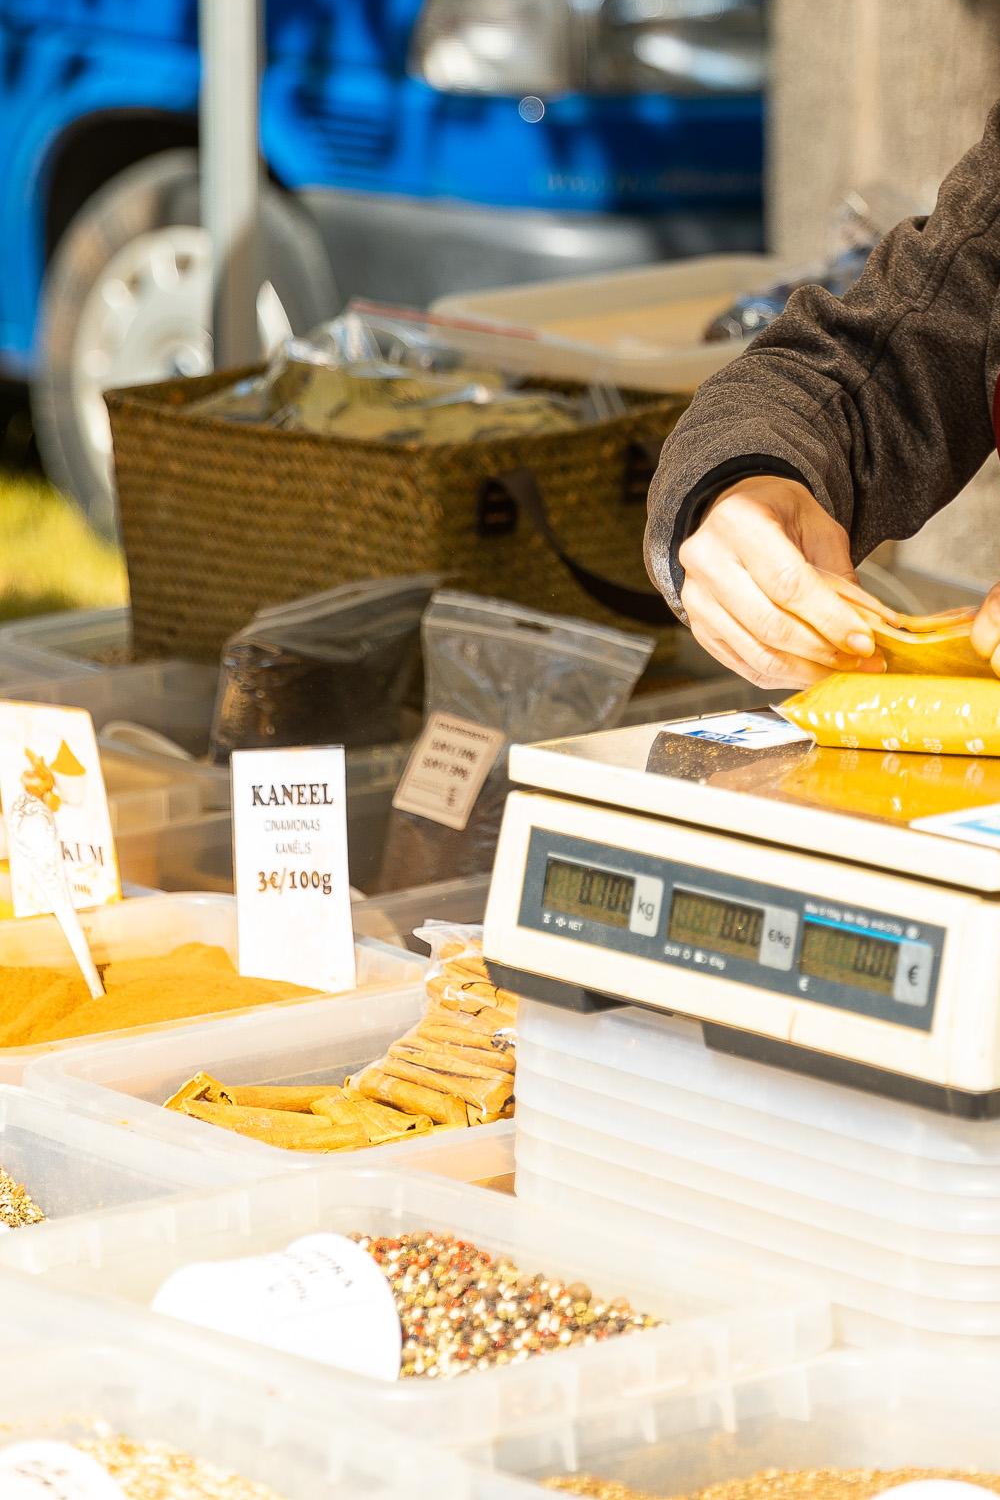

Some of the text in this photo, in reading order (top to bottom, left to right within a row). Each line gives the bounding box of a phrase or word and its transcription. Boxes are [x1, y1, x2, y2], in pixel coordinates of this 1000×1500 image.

[251, 783, 334, 807] KANEEL
[257, 867, 333, 895] 3€/100g
[636, 895, 656, 922] kg
[568, 920, 584, 933] NET
[767, 928, 793, 950] €/kg
[907, 964, 921, 987] €
